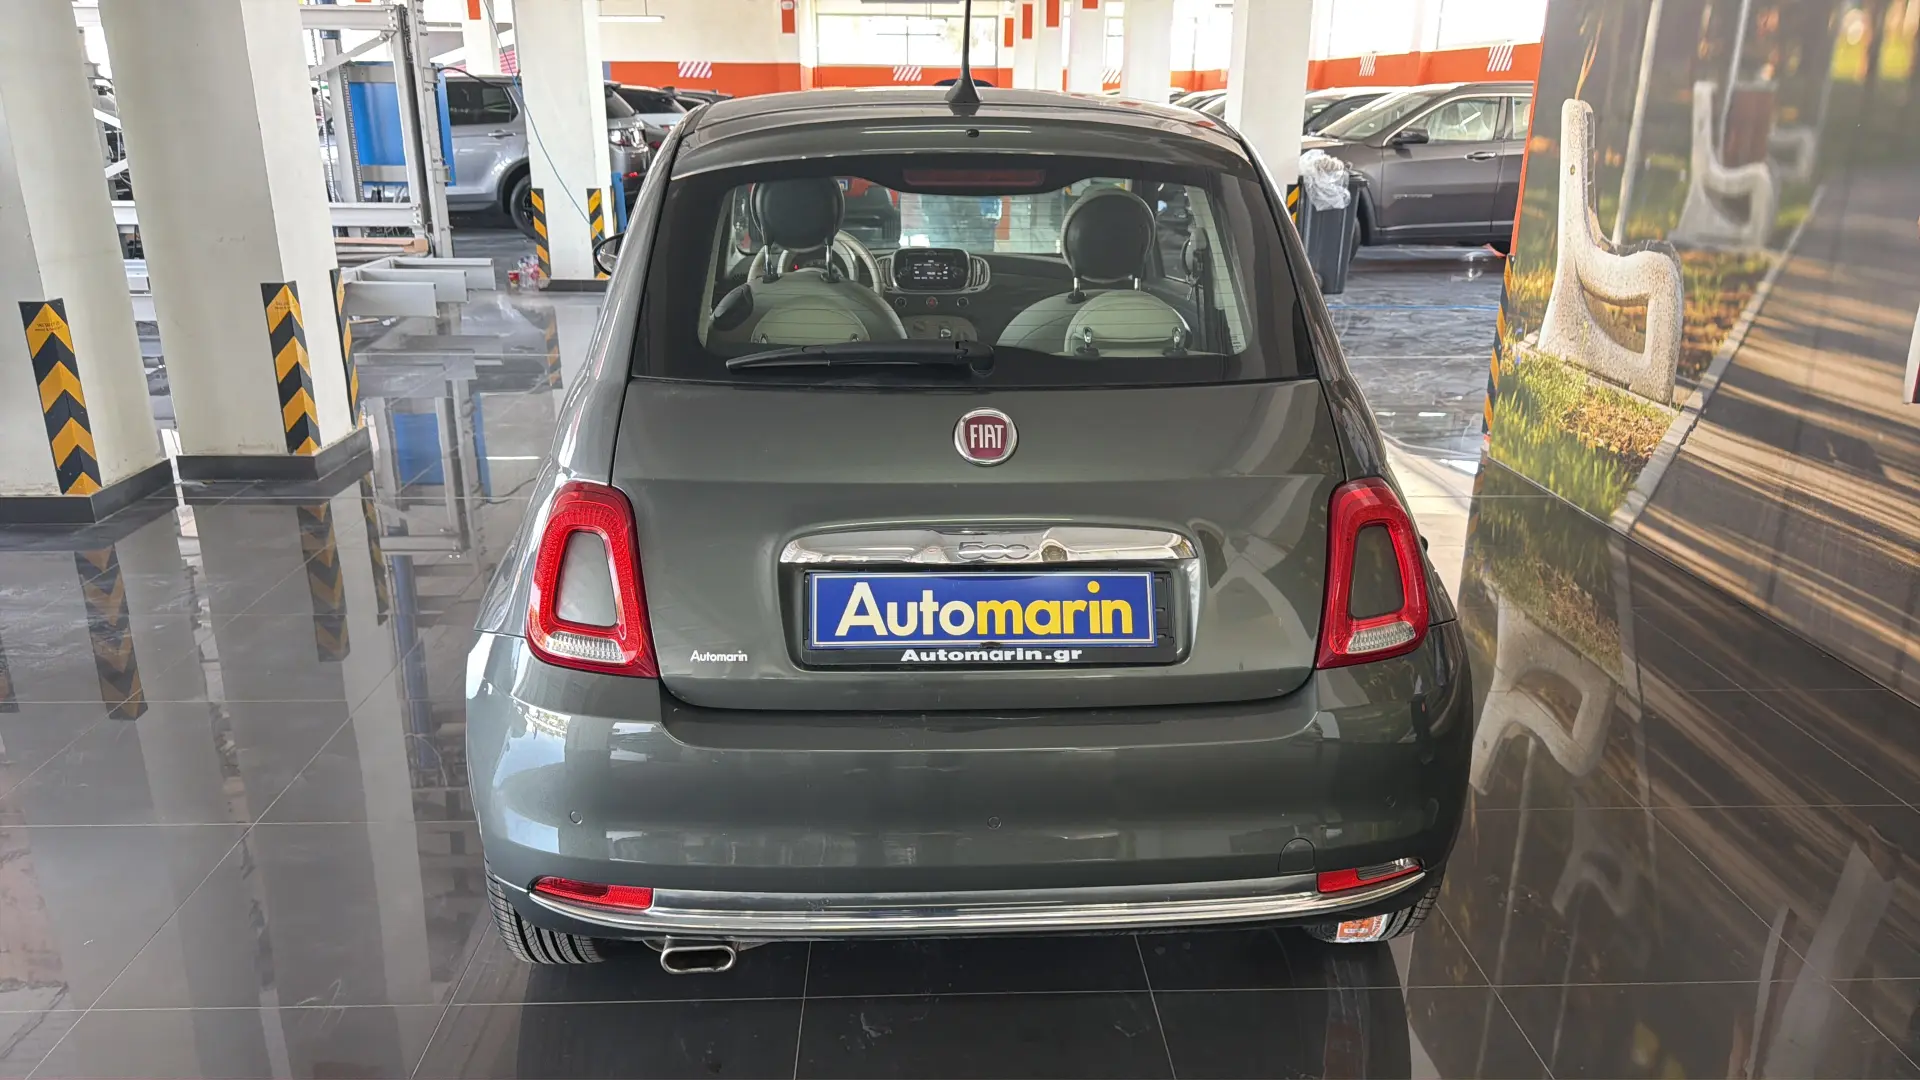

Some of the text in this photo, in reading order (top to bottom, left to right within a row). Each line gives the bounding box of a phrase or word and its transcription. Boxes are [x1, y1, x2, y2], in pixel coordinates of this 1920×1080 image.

[969, 424, 1005, 449] FIAT
[958, 541, 1030, 560] 500
[834, 580, 1133, 637] Automarin
[690, 649, 748, 662] Automarin
[900, 648, 1083, 663] Automarin.gr
